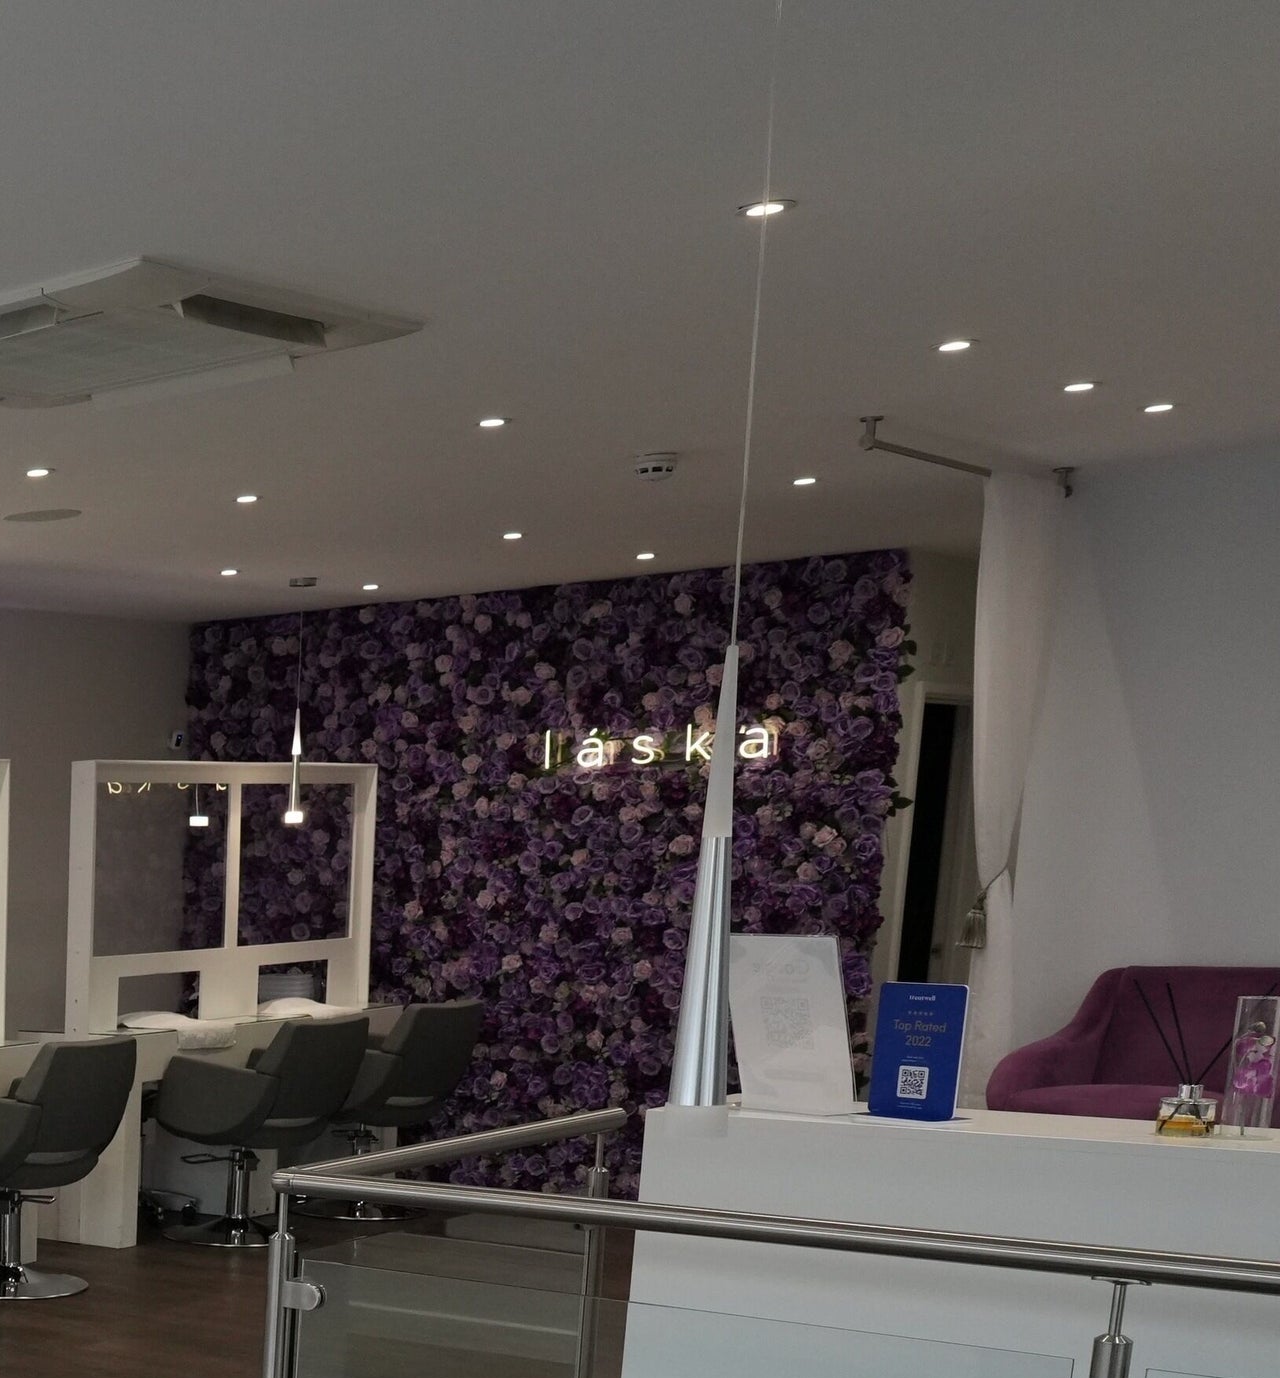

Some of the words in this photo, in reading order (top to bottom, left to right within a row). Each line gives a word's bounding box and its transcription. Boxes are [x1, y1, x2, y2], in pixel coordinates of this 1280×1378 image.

[544, 723, 771, 769] láska
[893, 1019, 912, 1033] Top
[915, 1020, 947, 1033] Rated
[905, 1035, 932, 1047] 2022
